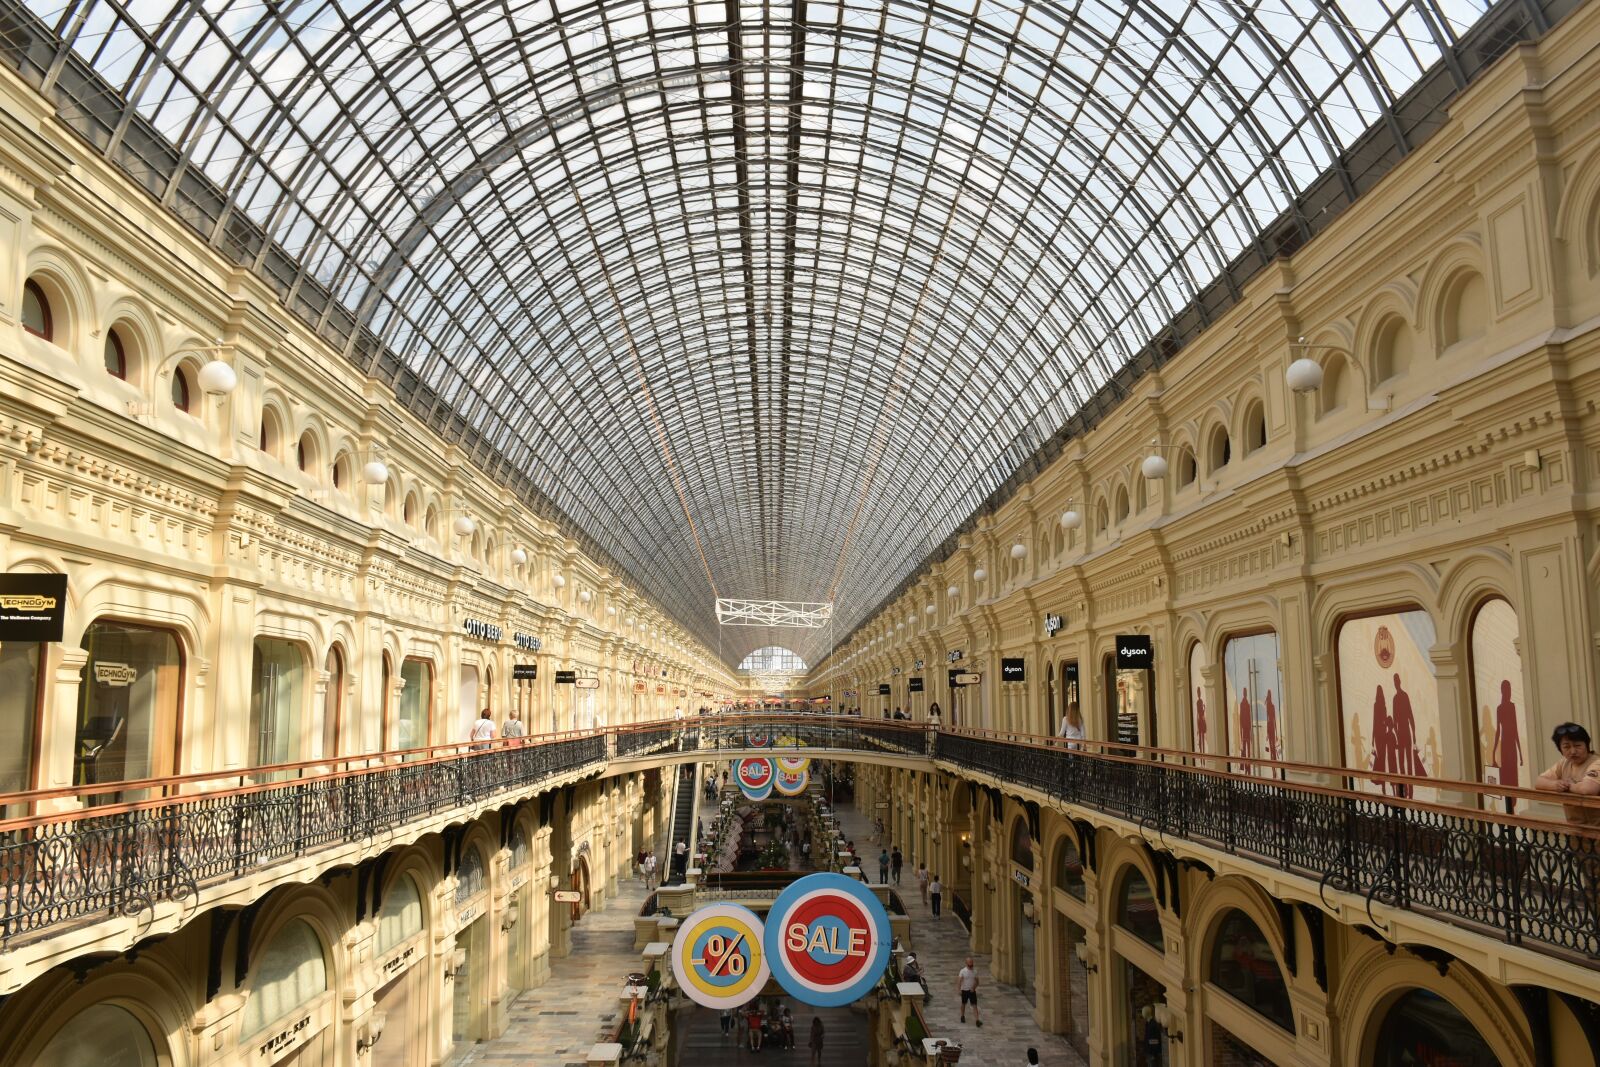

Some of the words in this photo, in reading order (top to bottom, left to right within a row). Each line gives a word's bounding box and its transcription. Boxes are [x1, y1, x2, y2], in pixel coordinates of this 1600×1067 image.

[467, 619, 485, 637] OTTO
[487, 624, 503, 641] BERG
[1121, 647, 1146, 657] dyson
[741, 766, 769, 777] SALE
[787, 923, 868, 957] SALE
